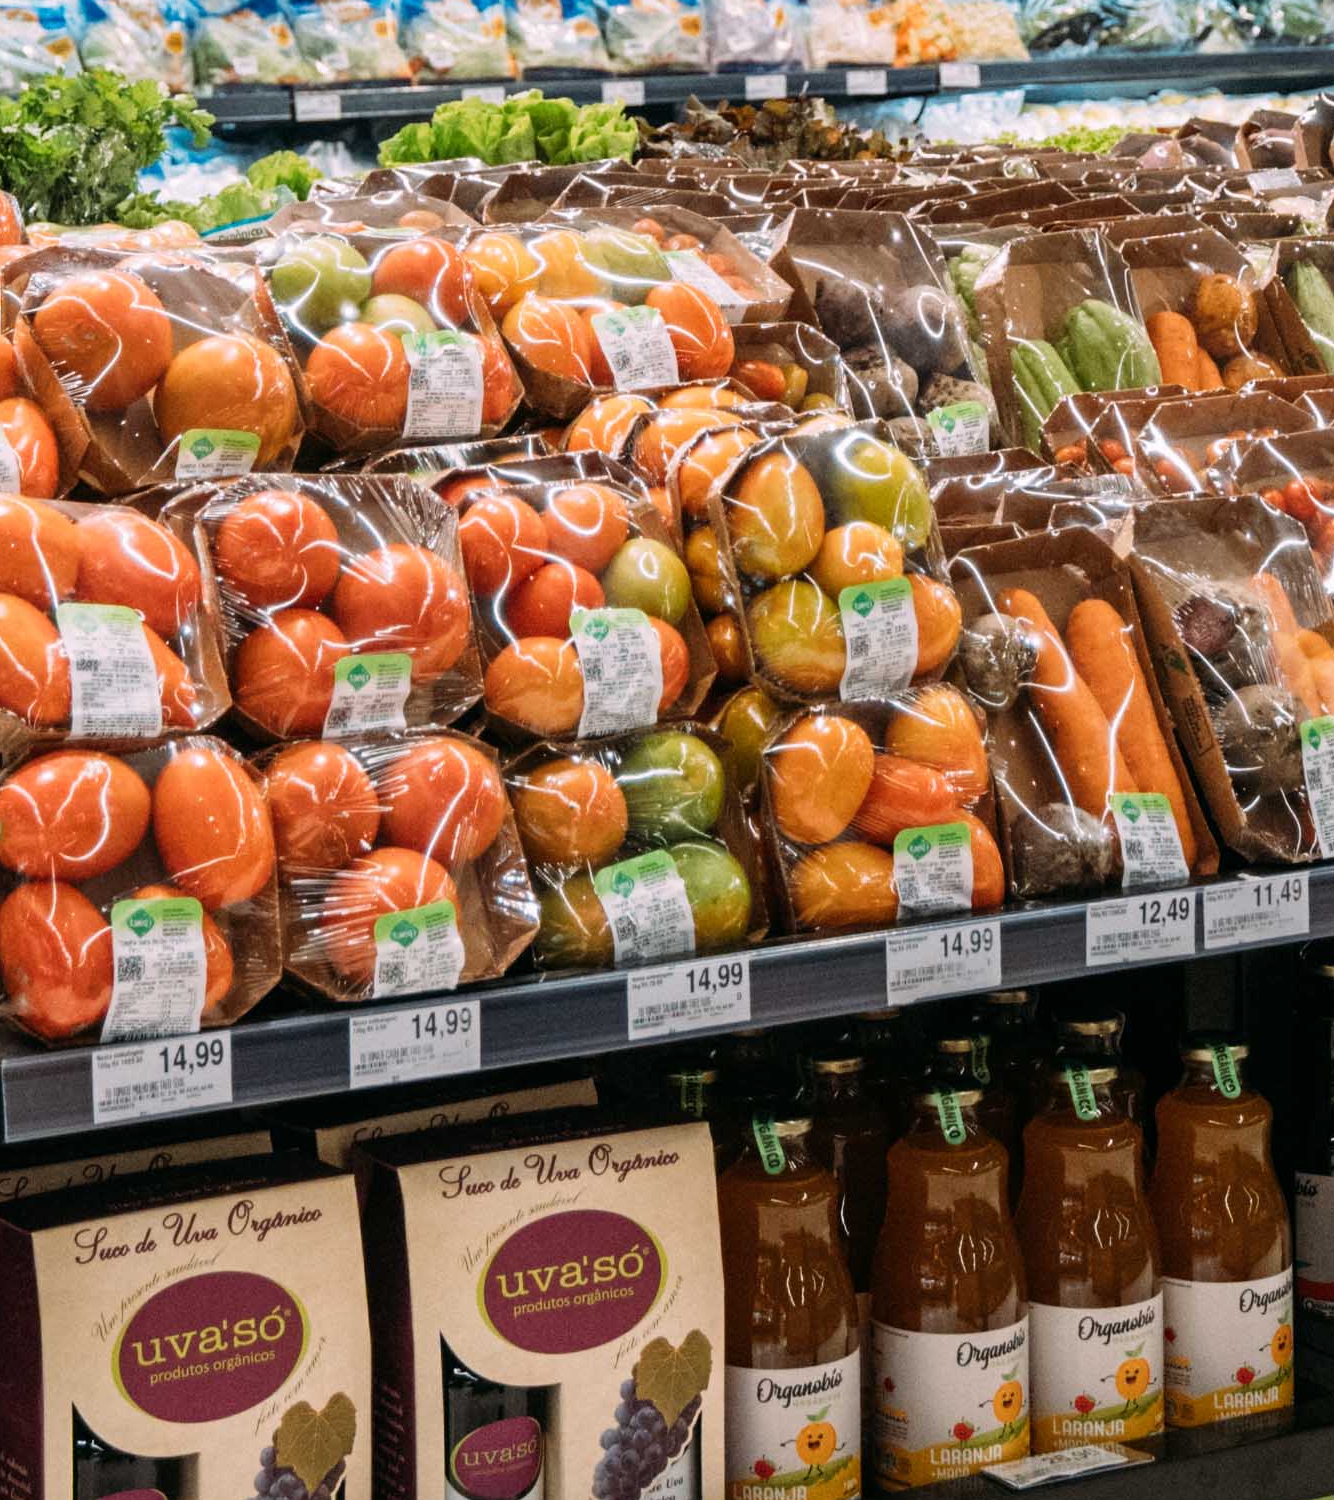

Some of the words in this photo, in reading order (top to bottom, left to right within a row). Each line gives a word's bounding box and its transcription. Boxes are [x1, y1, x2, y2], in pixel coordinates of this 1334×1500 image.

[1252, 878, 1303, 908] 11,49
[1138, 896, 1190, 927] 12,49
[939, 928, 994, 960] 14,99
[685, 961, 744, 997] 14,99
[411, 1006, 473, 1042] 14,99
[158, 1038, 225, 1076] 14,99
[438, 1164, 496, 1200] Suco
[500, 1165, 521, 1191] de
[524, 1153, 581, 1185] Uva
[588, 1143, 680, 1183] Orgânico
[74, 1227, 132, 1265] Suco
[135, 1228, 157, 1255] de
[162, 1212, 218, 1247] Uva
[227, 1199, 323, 1242] Orgânico
[513, 1295, 571, 1319] produtos
[573, 1284, 635, 1306] orgânicos
[149, 1356, 210, 1388] produtos
[213, 1349, 276, 1373] orgânicos
[1213, 1385, 1279, 1410] LARANJA
[1052, 1415, 1125, 1438] LARANJA
[930, 1444, 1004, 1465] LARANJA
